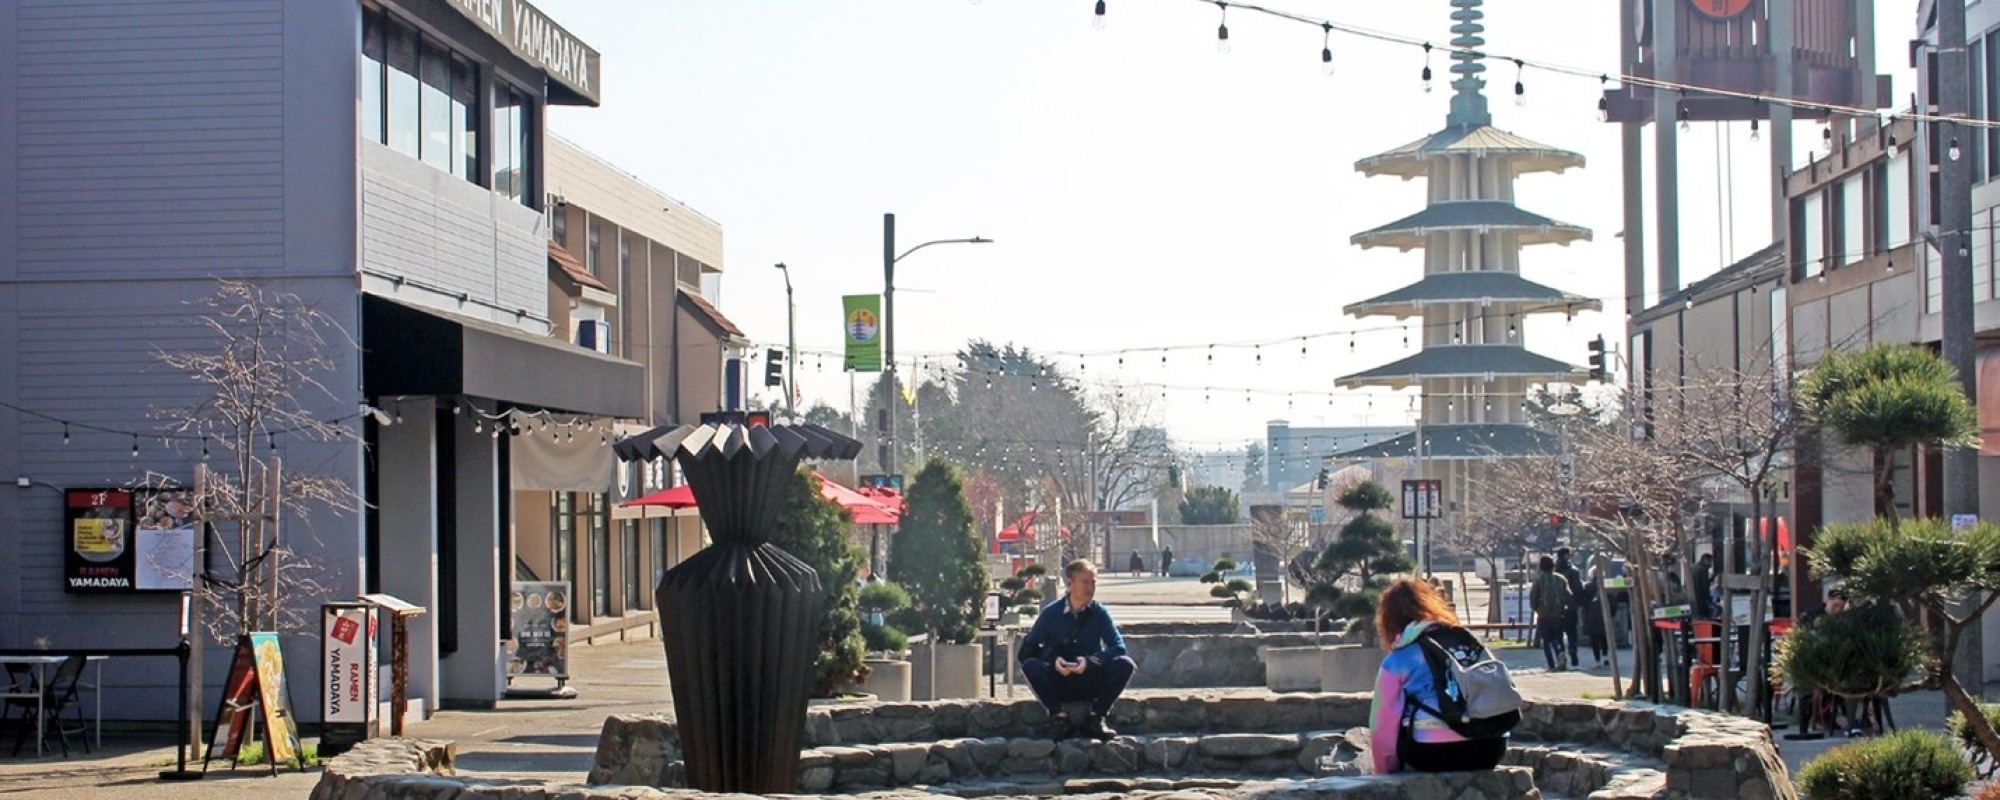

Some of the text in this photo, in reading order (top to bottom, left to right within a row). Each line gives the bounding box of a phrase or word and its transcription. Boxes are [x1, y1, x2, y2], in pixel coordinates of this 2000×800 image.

[512, 0, 589, 92] YAMADAYA
[91, 493, 107, 505] 2F
[70, 578, 129, 587] YAMADAYA
[79, 567, 119, 576] RAMEN
[330, 648, 341, 715] YAMADAYA
[350, 663, 359, 702] RAMEN
